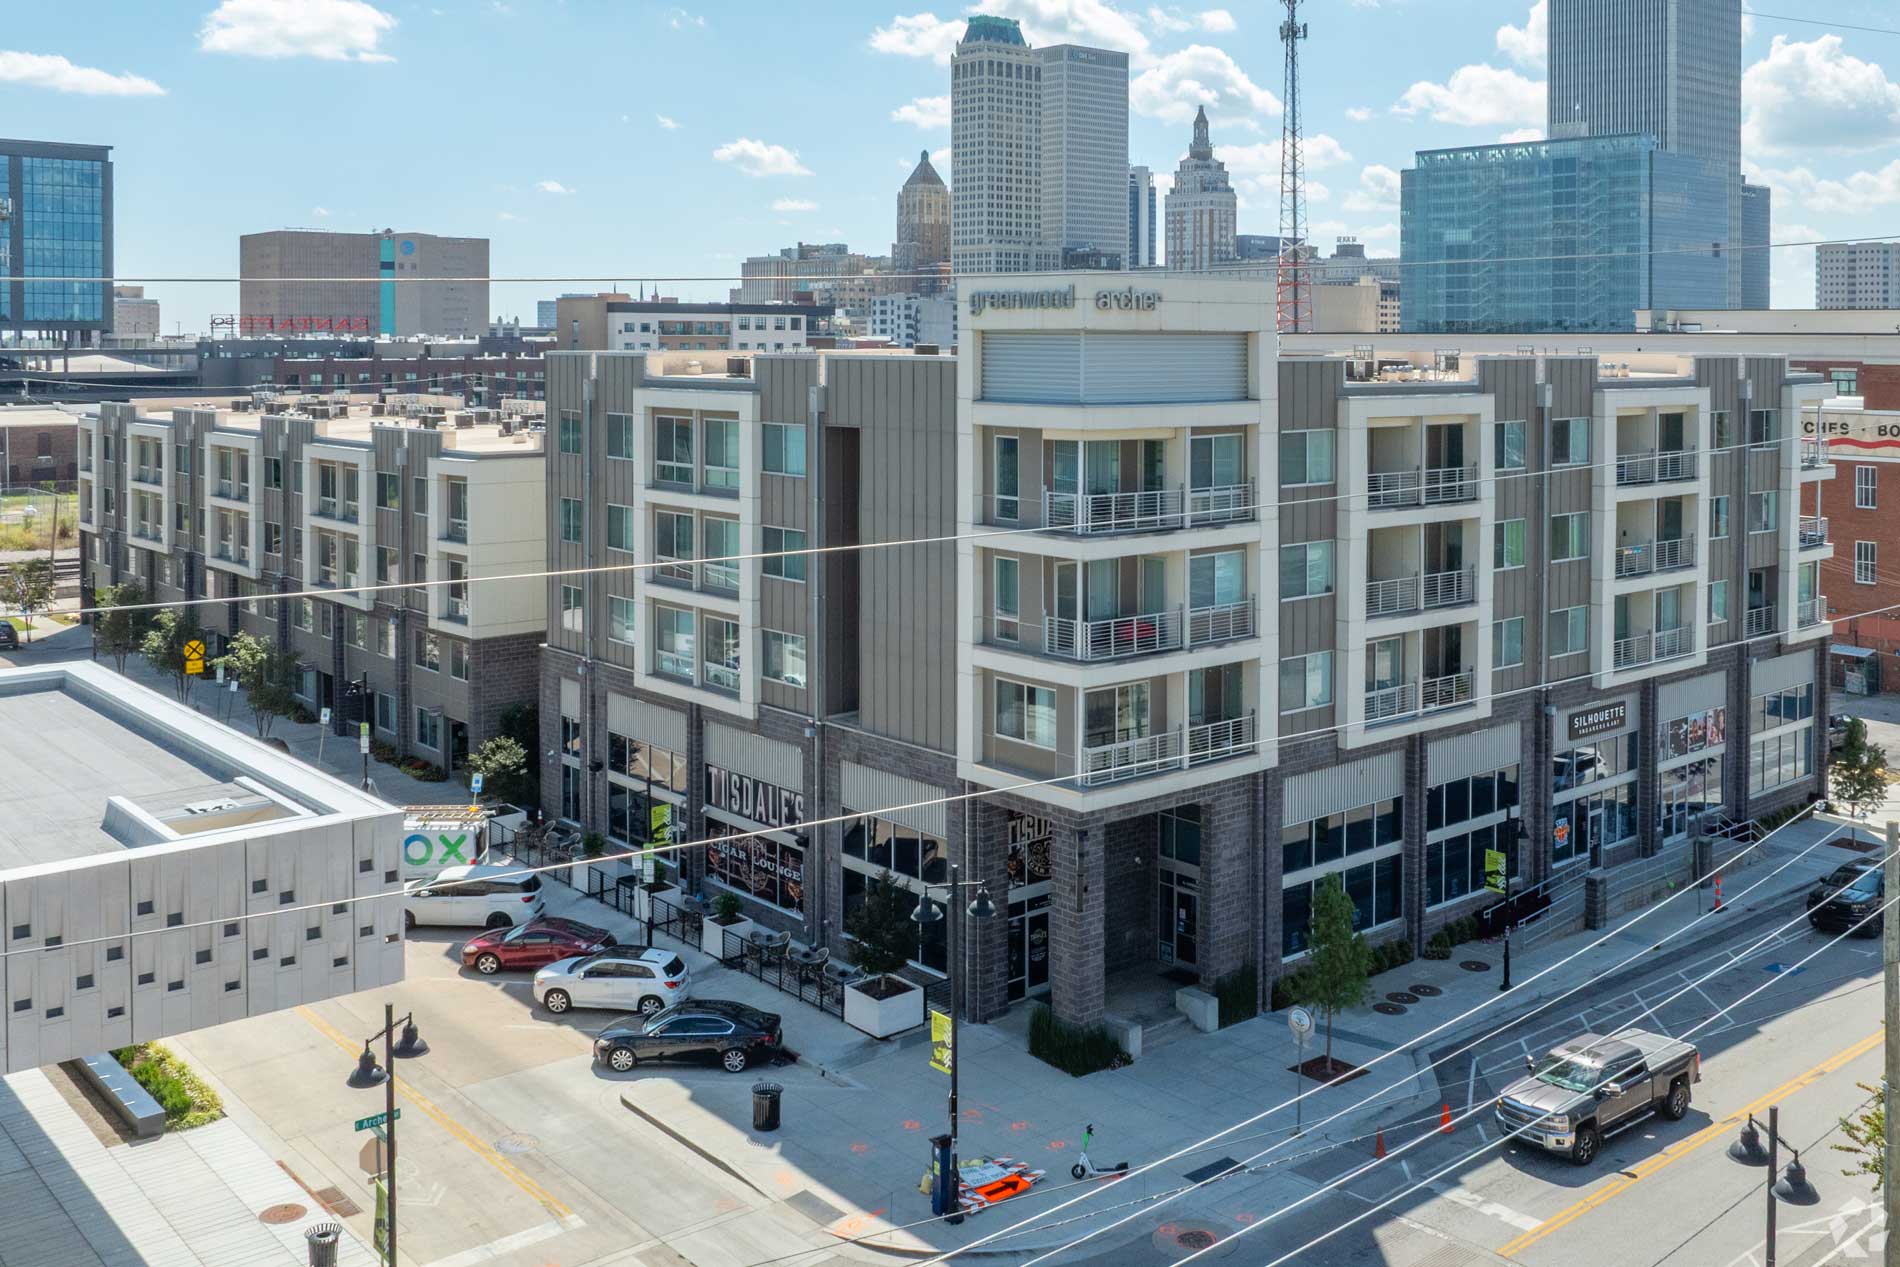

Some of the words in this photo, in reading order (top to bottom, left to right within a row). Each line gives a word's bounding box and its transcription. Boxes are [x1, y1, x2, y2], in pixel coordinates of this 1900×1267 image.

[969, 284, 1075, 316] greenwood
[1096, 286, 1161, 311] archer
[1801, 421, 1850, 435] CHES
[1574, 706, 1625, 728] SILHOUETTE
[708, 766, 804, 833] TISDALE'S
[710, 841, 747, 861] CIGAR
[753, 856, 801, 881] LOUNGE
[362, 1114, 387, 1129] Arche
